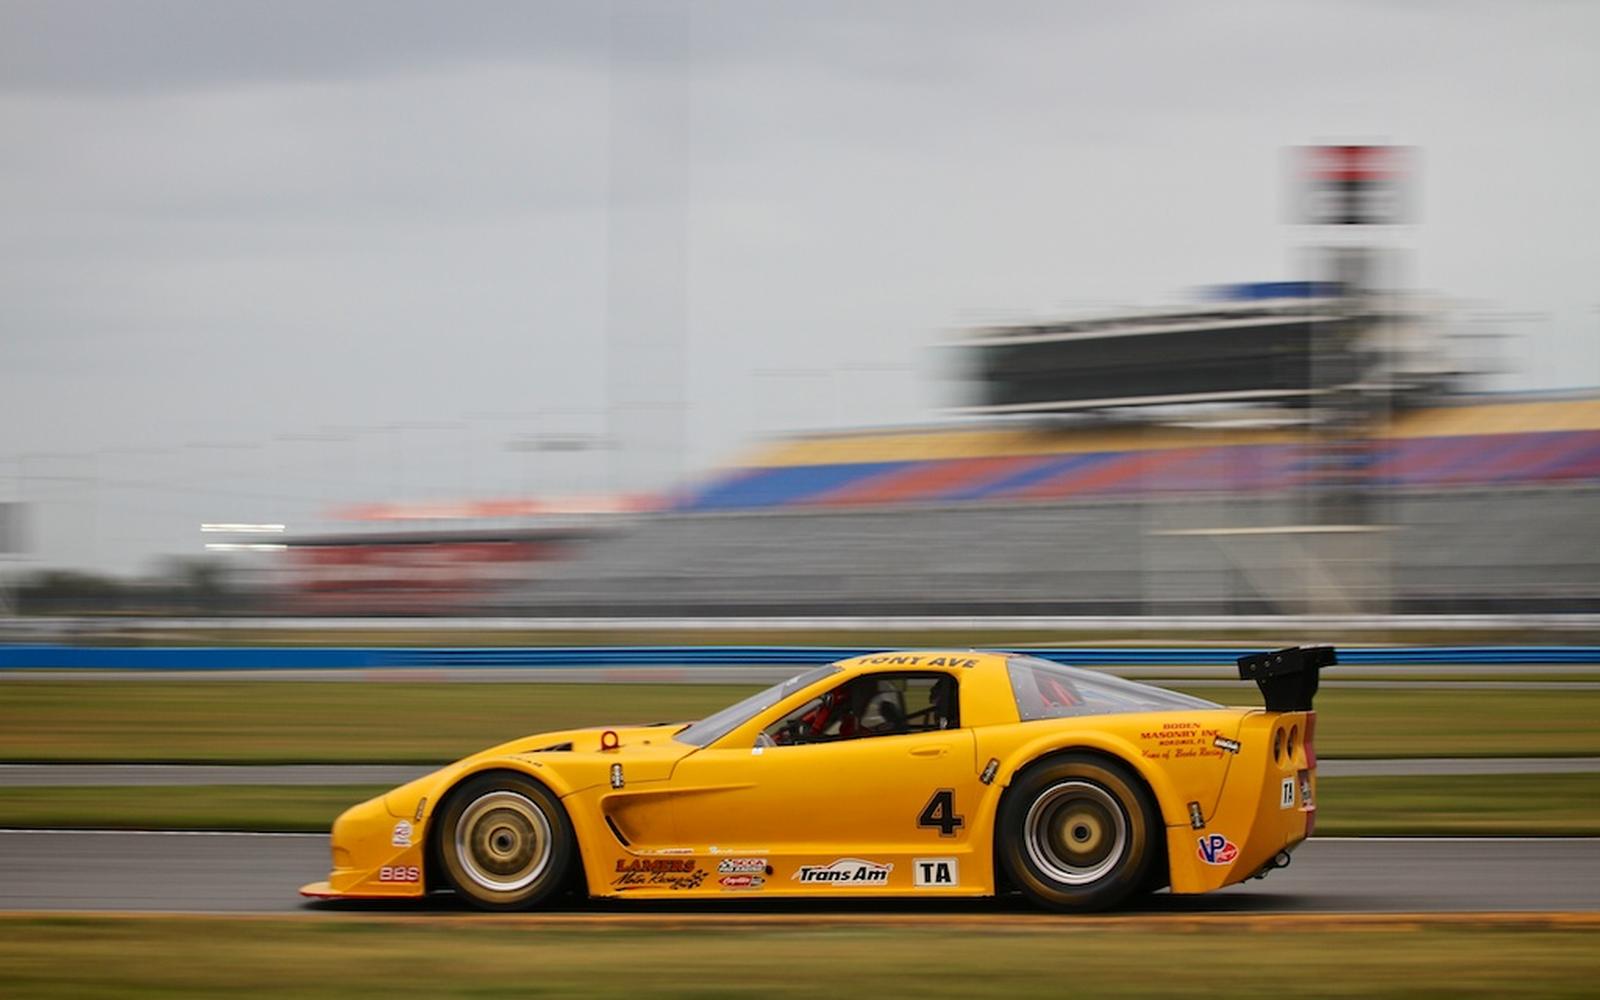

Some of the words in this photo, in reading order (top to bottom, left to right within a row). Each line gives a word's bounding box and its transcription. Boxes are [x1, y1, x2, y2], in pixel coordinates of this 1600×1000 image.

[859, 656, 927, 665] TONY
[927, 657, 980, 669] AVE
[1141, 730, 1197, 739] MASONRY
[1284, 782, 1293, 804] TA
[916, 787, 965, 838] 4
[1199, 835, 1225, 863] VP
[615, 858, 696, 873] LAMERS
[920, 863, 951, 883] TA
[379, 867, 420, 881] BBS
[800, 868, 851, 881] Trans
[853, 866, 887, 881] Am
